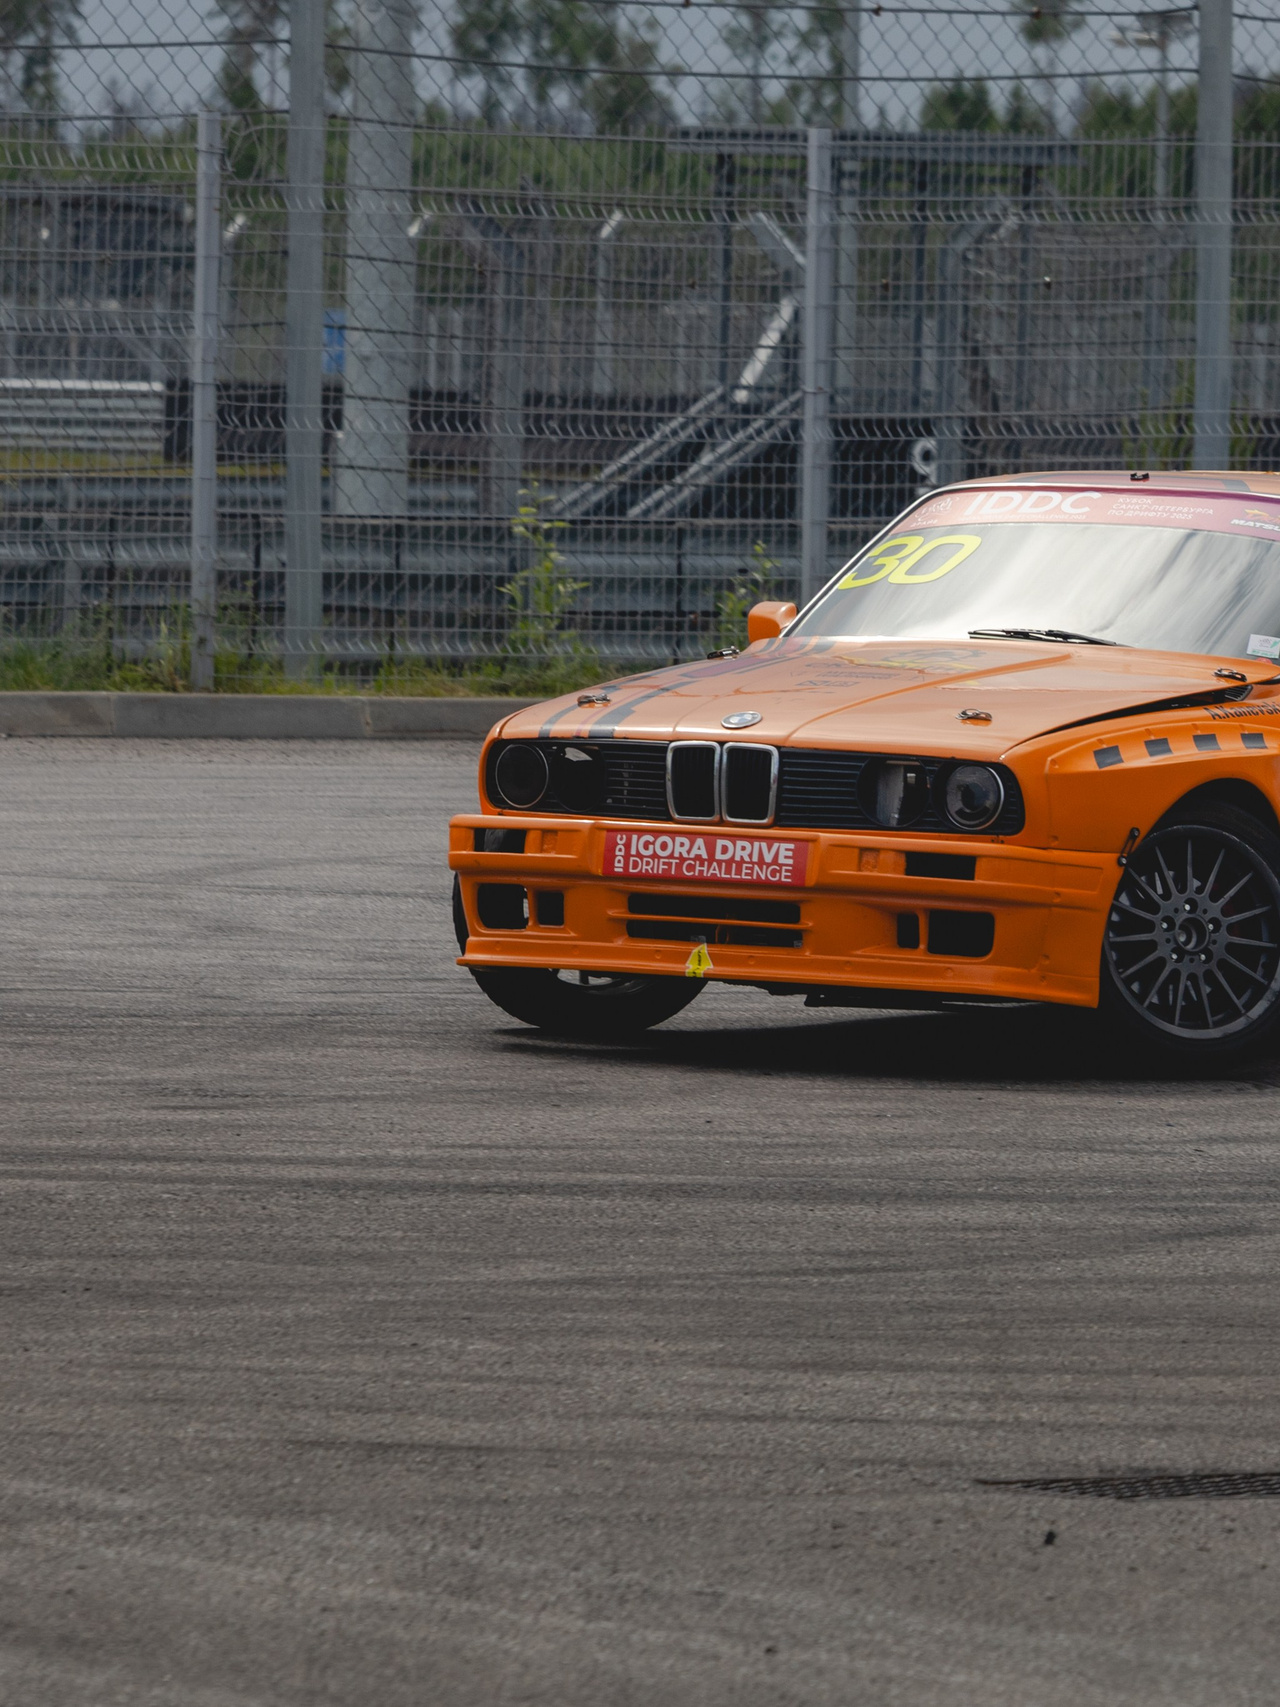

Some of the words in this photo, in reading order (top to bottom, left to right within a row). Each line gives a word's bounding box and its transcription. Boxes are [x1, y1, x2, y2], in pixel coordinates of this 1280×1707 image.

[963, 491, 1103, 515] IDDC
[1112, 503, 1215, 516] САНКТ-ПЕТЕРБУРГА
[1117, 497, 1153, 505] КУБОК
[1125, 510, 1172, 519] ДРИФТУ
[838, 534, 982, 590] 30
[613, 834, 627, 872] IDDC
[630, 834, 708, 859] IGORA
[715, 839, 796, 865] DRIVE
[628, 857, 680, 876] DRIFT
[682, 859, 793, 882] CHALLENGE
